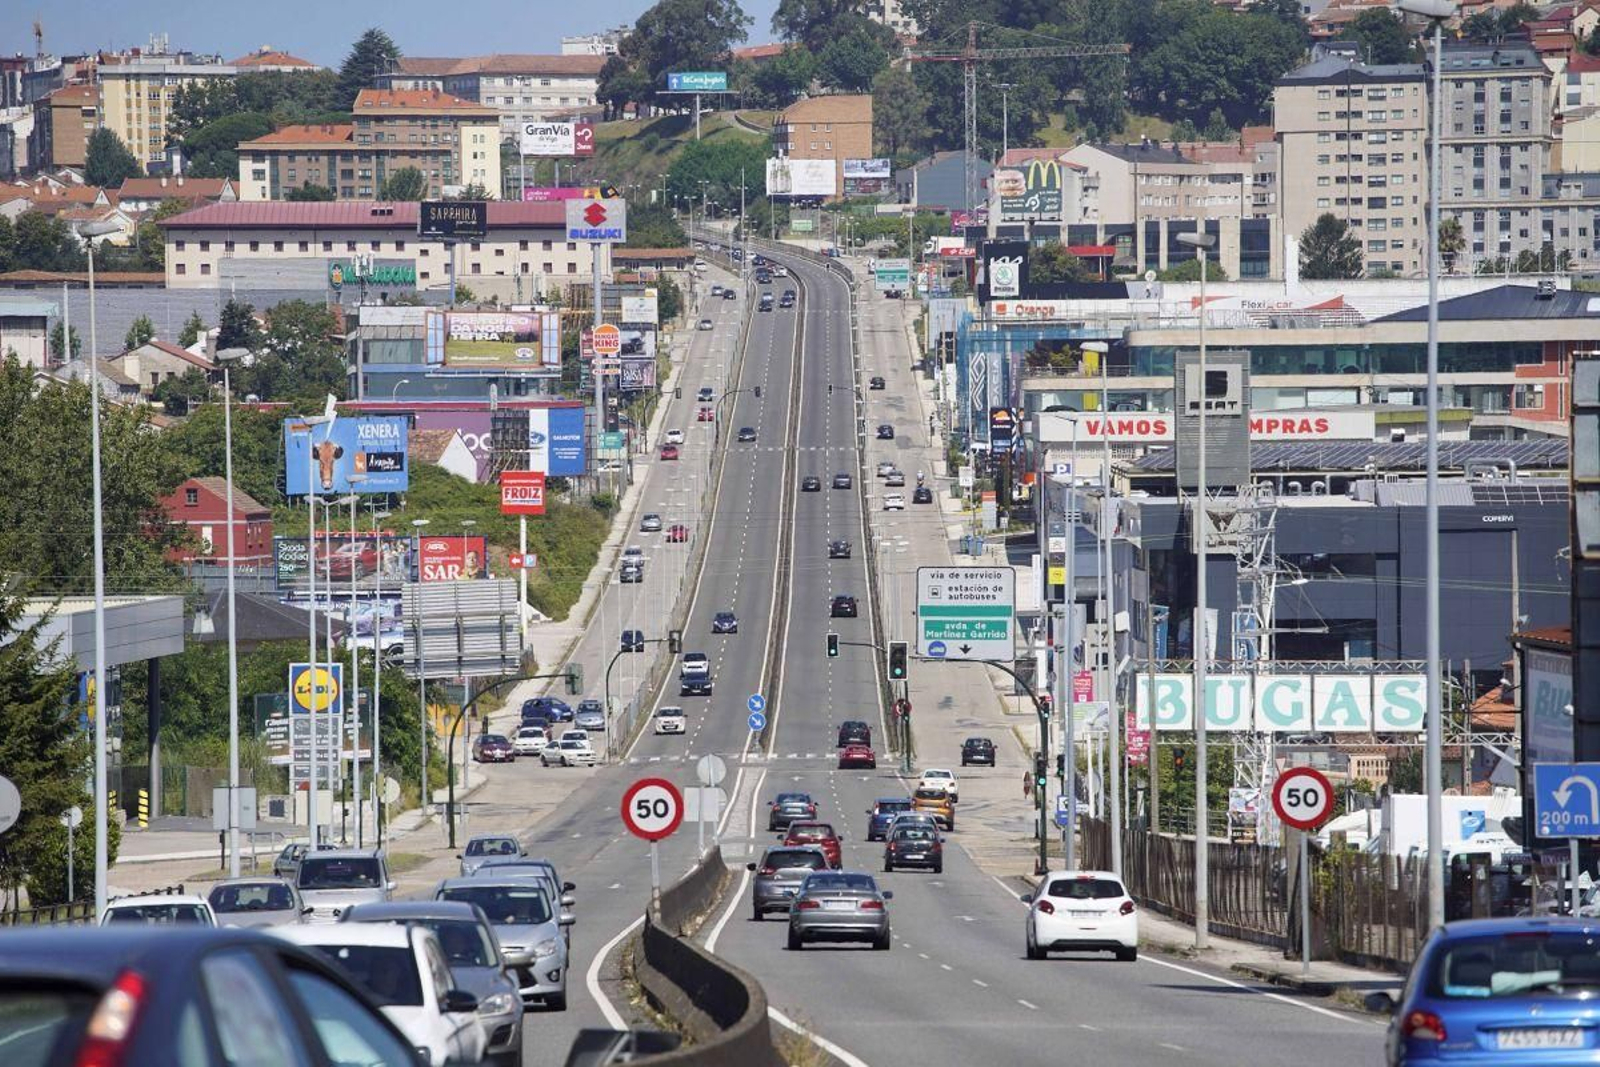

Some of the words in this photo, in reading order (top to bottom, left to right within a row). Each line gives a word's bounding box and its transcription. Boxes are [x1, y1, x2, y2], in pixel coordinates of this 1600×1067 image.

[429, 206, 477, 221] SAPPHIRA
[569, 228, 622, 240] SUZUKI
[1015, 304, 1056, 317] Orange
[594, 339, 619, 348] KING
[1189, 400, 1239, 411] SEAT
[357, 423, 400, 439] XENERA
[1086, 419, 1168, 436] VAMOS
[1249, 418, 1330, 434] MPRAS
[1056, 464, 1067, 475] P
[504, 487, 541, 499] FROIZ
[278, 552, 309, 562] Kodiaq
[424, 563, 461, 581] SAR
[948, 571, 960, 579] de
[964, 571, 1002, 579] servicio
[948, 584, 989, 592] estación
[970, 630, 1006, 638] Garrido
[1140, 679, 1424, 727] BUGAS
[1286, 788, 1320, 808] 50
[637, 798, 670, 819] 50
[1541, 811, 1571, 825] 200
[1574, 814, 1589, 825] m
